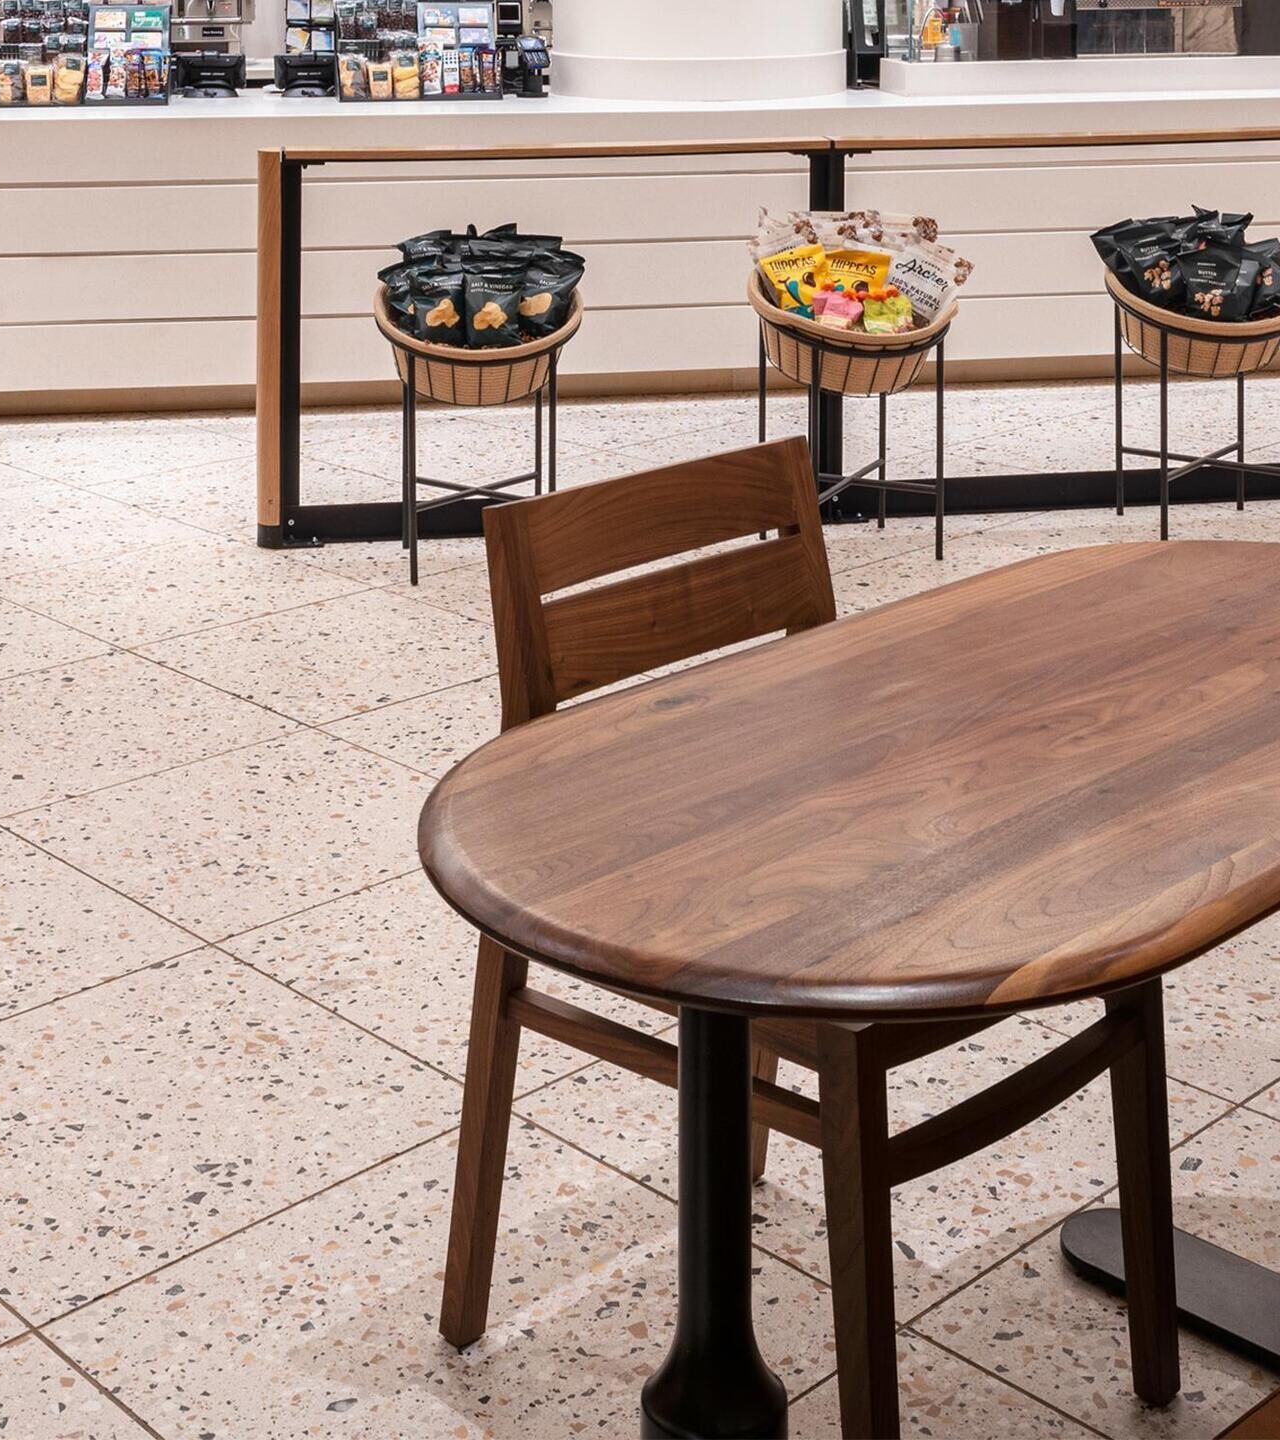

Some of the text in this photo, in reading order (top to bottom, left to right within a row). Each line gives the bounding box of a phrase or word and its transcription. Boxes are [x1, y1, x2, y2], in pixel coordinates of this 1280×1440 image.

[769, 256, 816, 271] HIPPEAS
[831, 258, 877, 275] HIPPEAS
[891, 276, 908, 287] 100%
[895, 259, 948, 292] Archer
[910, 285, 941, 306] NATURAL
[916, 296, 939, 311] JERKY
